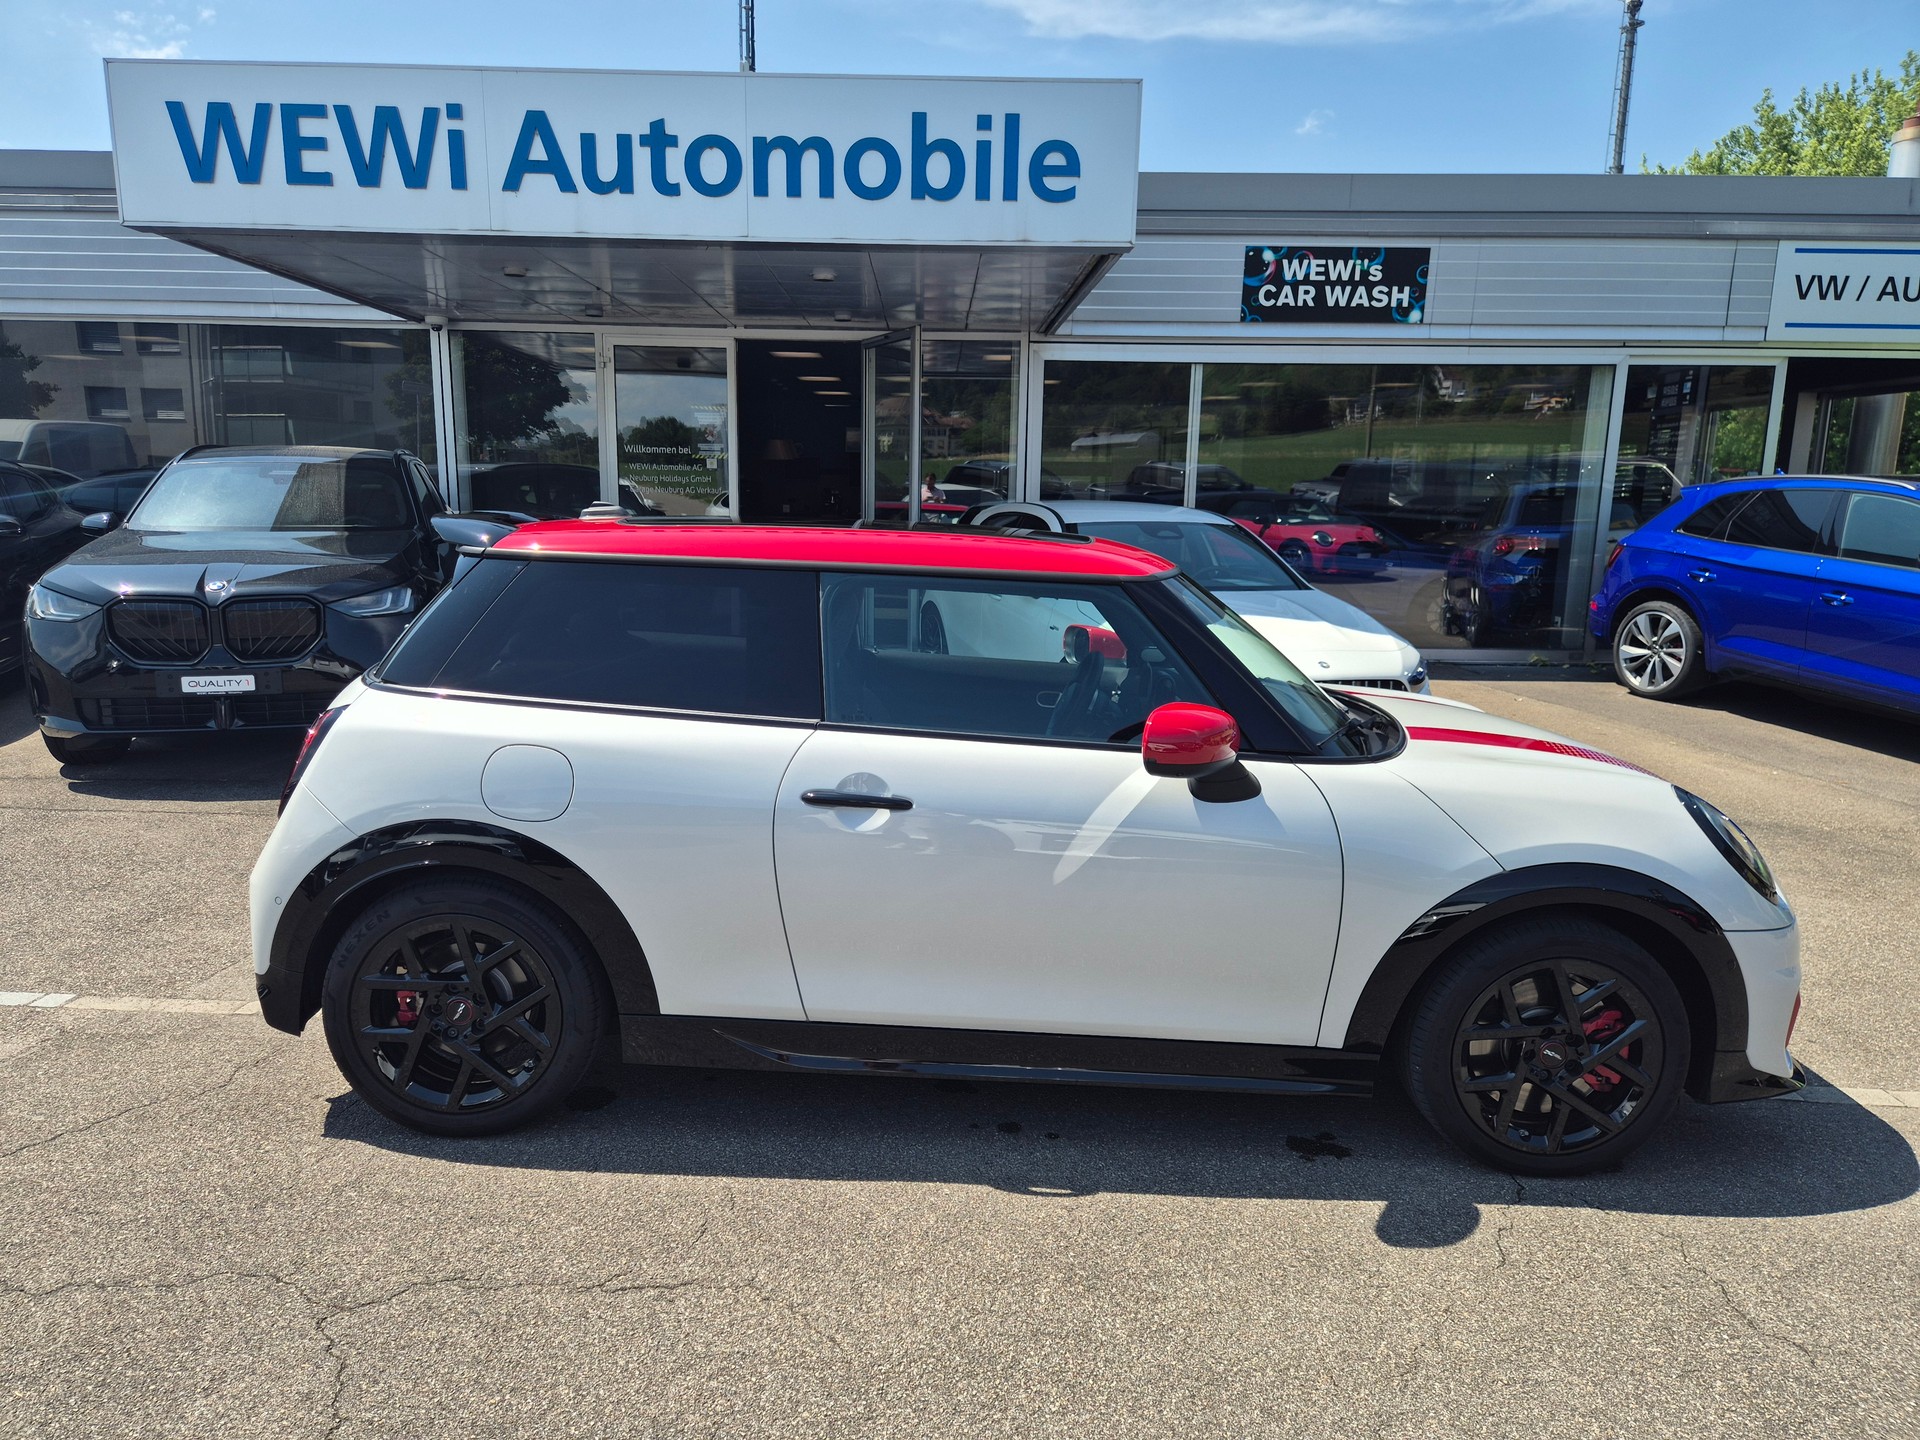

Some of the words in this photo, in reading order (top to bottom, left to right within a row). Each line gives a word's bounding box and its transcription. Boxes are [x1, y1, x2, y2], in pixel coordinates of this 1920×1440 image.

[163, 99, 468, 190] WEWi
[501, 109, 1083, 203] Automobile
[1282, 258, 1383, 282] WEWi's
[1258, 284, 1316, 307] CAR
[1324, 285, 1410, 308] WASH
[1795, 274, 1850, 301] VW
[624, 444, 677, 454] Willkommen
[678, 445, 692, 455] bei
[629, 463, 651, 471] WEWi
[652, 463, 691, 472] Automobile
[692, 464, 703, 472] AG
[629, 474, 659, 483] Neuburg
[660, 474, 690, 484] Holidays
[690, 475, 712, 483] GmbH
[655, 486, 684, 495] Neuburg
[685, 486, 696, 494] AG
[696, 486, 722, 495] Verkauf
[187, 679, 243, 688] QUALITY
[337, 909, 391, 968] NEXEN
